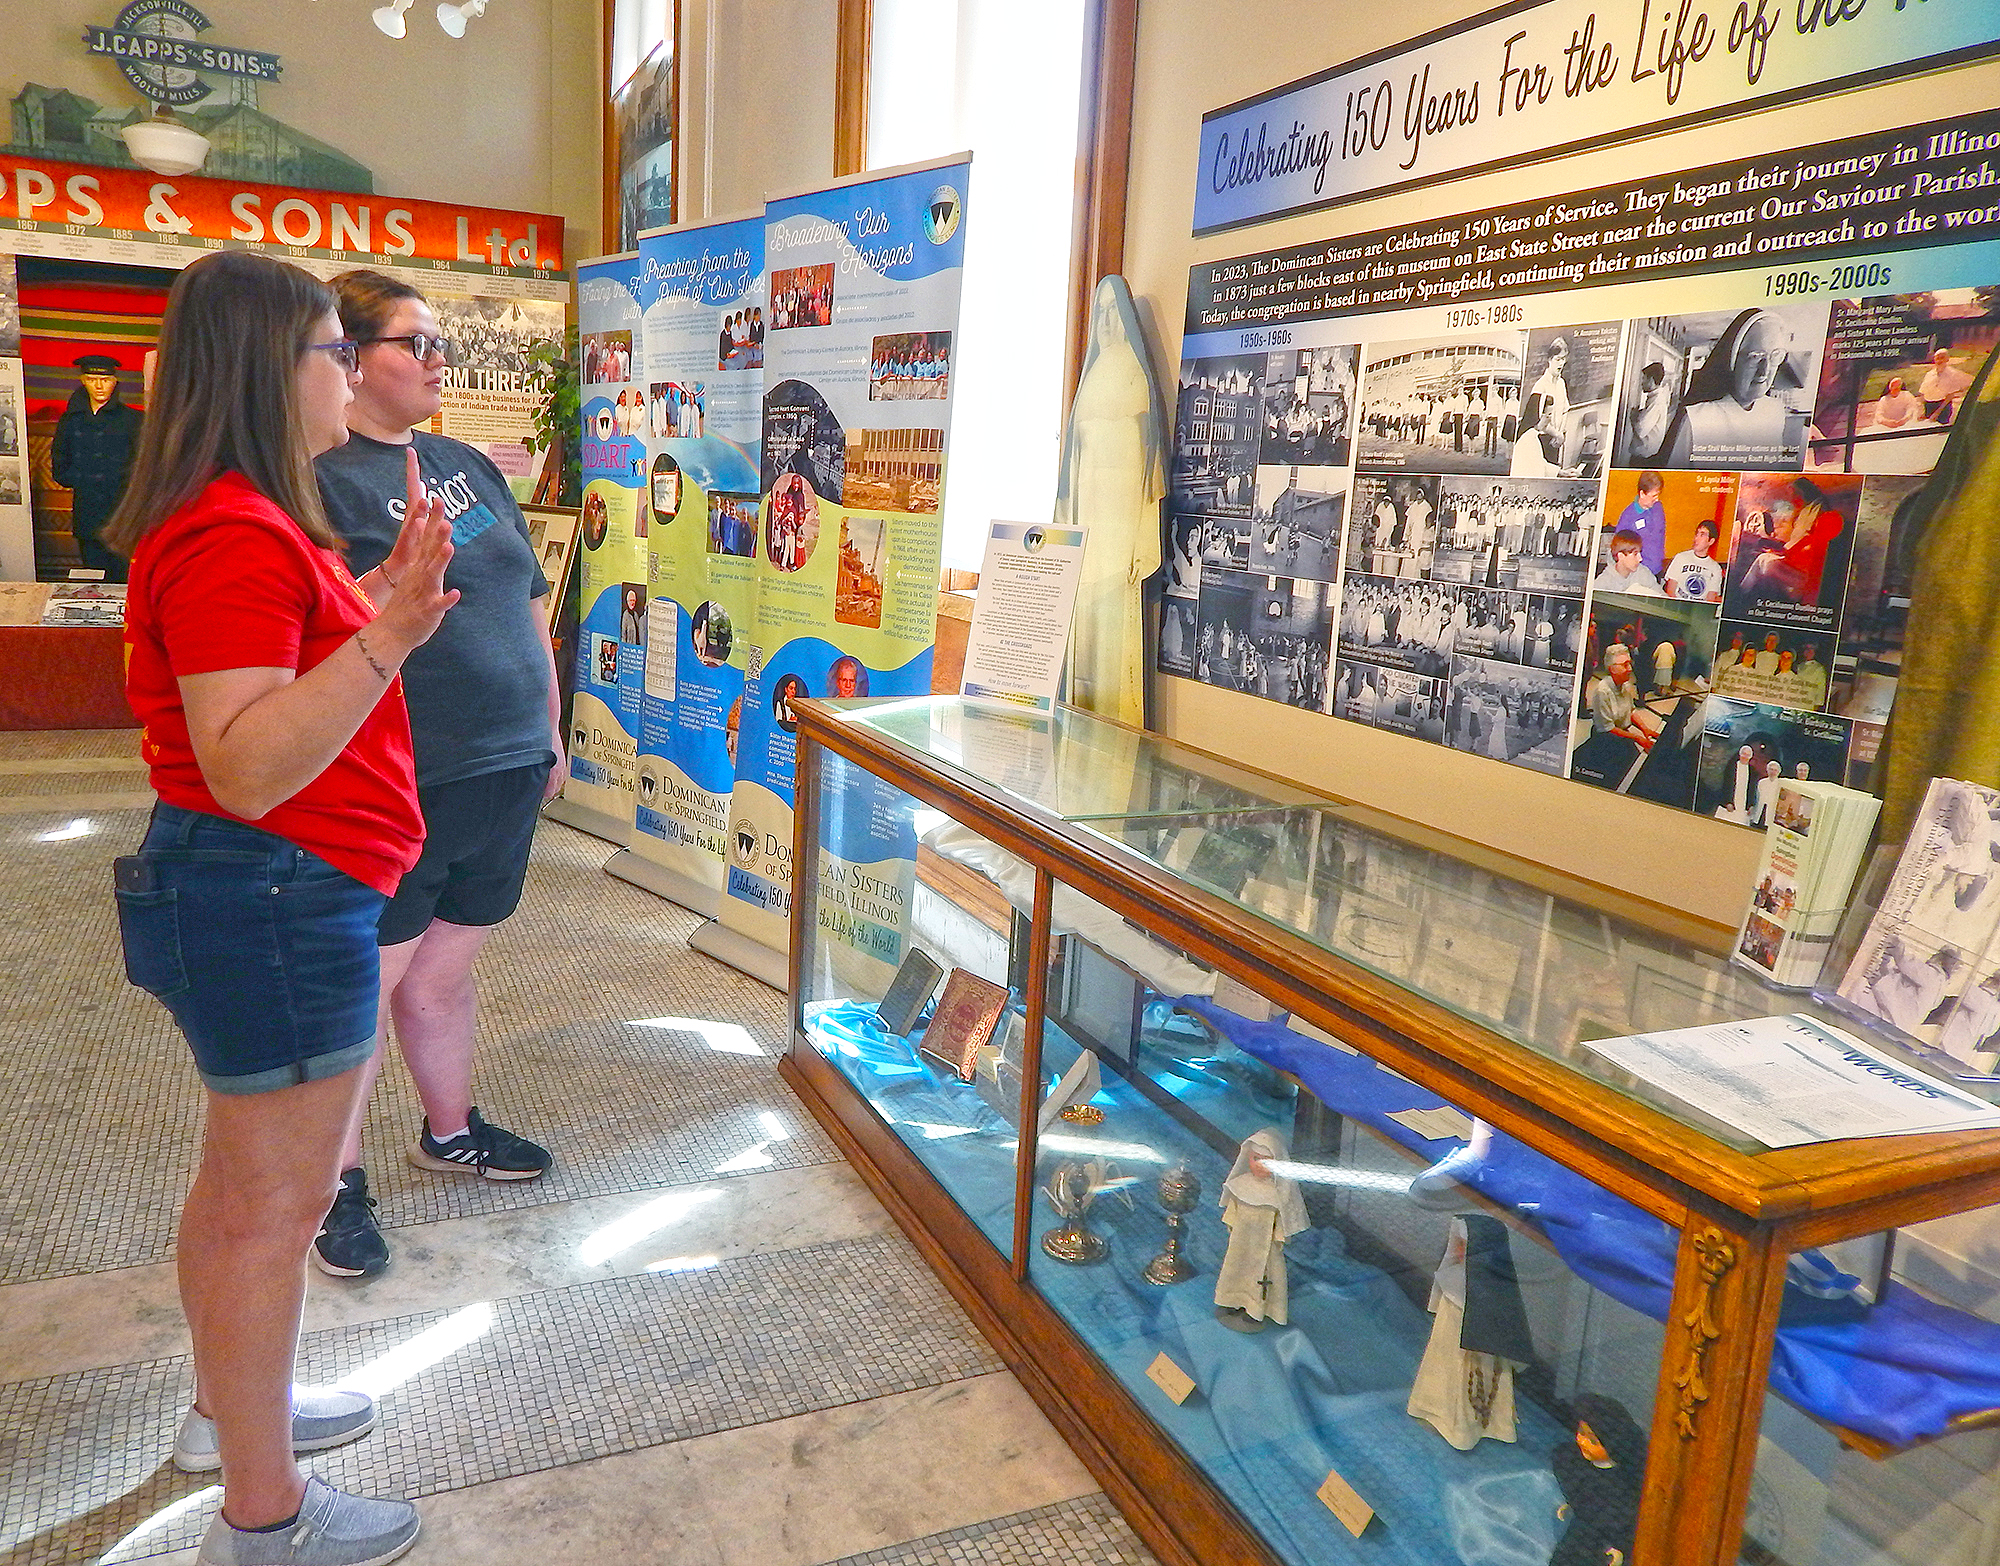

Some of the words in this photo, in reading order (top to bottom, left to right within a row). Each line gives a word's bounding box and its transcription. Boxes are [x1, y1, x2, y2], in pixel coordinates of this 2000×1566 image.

[126, 65, 165, 98] WOOLEN
[1213, 118, 1333, 195] Celebrating
[1341, 79, 1392, 160] 150
[1400, 62, 1479, 170] Years
[1498, 30, 1553, 117] For
[1564, 13, 1619, 98] the
[1630, 0, 1716, 105] Life
[1727, 0, 1780, 85] of
[0, 168, 104, 228] PS
[143, 183, 193, 236] &
[230, 192, 417, 258] SONS
[456, 215, 555, 270] Ltd.
[17, 220, 38, 231] 1867
[1211, 268, 1221, 284] In
[1223, 264, 1249, 280] 2023,
[1251, 260, 1269, 276] The
[1271, 254, 1324, 273] Domincan
[1326, 247, 1362, 264] Sisters
[1364, 244, 1383, 257] are
[1386, 228, 1461, 253] Celebrating
[1463, 219, 1490, 240] 150
[1492, 214, 1531, 235] Years
[1534, 206, 1555, 228] of
[1554, 200, 1619, 224] Service.
[1624, 189, 1670, 214] They
[1673, 180, 1732, 208] began
[1737, 165, 1791, 193] their
[1791, 151, 1888, 192] journey
[1891, 142, 1918, 166] in
[65, 224, 87, 236] 1872
[112, 229, 133, 240] 1885
[159, 233, 179, 244] 1886
[770, 218, 850, 252] Broadening
[855, 206, 890, 239] Our
[203, 238, 224, 249] 1890
[288, 246, 308, 257] 1904
[1213, 289, 1223, 303] in
[1224, 283, 1248, 301] 1873
[1248, 281, 1268, 302] just
[1269, 284, 1275, 295] a
[1276, 276, 1295, 293] few
[1296, 270, 1331, 291] blocks
[1333, 269, 1355, 285] east
[1356, 263, 1372, 282] of
[1371, 259, 1395, 278] this
[1396, 253, 1451, 276] museum
[1454, 251, 1472, 267] on
[1475, 244, 1507, 265] East
[1509, 237, 1548, 259] State
[1550, 229, 1600, 253] Street
[1602, 223, 1642, 245] near
[1646, 214, 1677, 238] the
[1680, 205, 1756, 234] current
[1760, 194, 1807, 221] Our
[1810, 181, 1906, 213] Saviour
[329, 250, 347, 261] 1917
[373, 254, 392, 265] 1939
[432, 259, 450, 270] 1964
[644, 257, 698, 284] Preaching
[697, 248, 731, 281] from
[733, 247, 751, 268] the
[841, 242, 915, 277] Horizons
[1200, 308, 1229, 327] Today,
[1230, 305, 1246, 321] the
[1247, 295, 1311, 320] congregation
[1312, 294, 1322, 310] is
[1324, 288, 1356, 308] based
[1357, 286, 1370, 305] in
[1372, 281, 1416, 304] nearby
[1416, 268, 1495, 299] Springfield,
[1498, 260, 1586, 288] continuing
[1589, 252, 1631, 275] their
[1633, 244, 1708, 270] mission
[1711, 231, 1753, 260] and
[1756, 217, 1855, 252] outreach
[1861, 220, 1888, 240] to
[1895, 208, 1937, 235] the
[1943, 199, 2000, 228] wor
[491, 265, 509, 276] 1975
[532, 269, 550, 279] 1975
[1764, 263, 1892, 297] 1990s-2000s
[611, 281, 626, 298] the
[656, 281, 690, 310] Pulpit
[692, 279, 705, 308] of
[708, 275, 734, 300] Our
[737, 271, 765, 300] Lives
[623, 302, 642, 320] with
[1446, 304, 1523, 328] 1970s-1980s
[1240, 329, 1292, 348] 1950s-1960s
[455, 392, 474, 400] 1800s
[481, 394, 491, 402] big
[493, 395, 520, 403] business
[469, 402, 489, 410] Indian
[491, 404, 508, 412] trade
[584, 444, 630, 469] SDART
[663, 776, 726, 814] DOMINICAN
[667, 820, 679, 838] 150
[680, 826, 695, 847] Years
[695, 830, 706, 849] For
[732, 871, 768, 909] Celebrating
[769, 881, 783, 906] 150
[850, 865, 905, 907] SISTERS
[852, 891, 900, 927] ILLINOIS
[832, 911, 847, 941] Life
